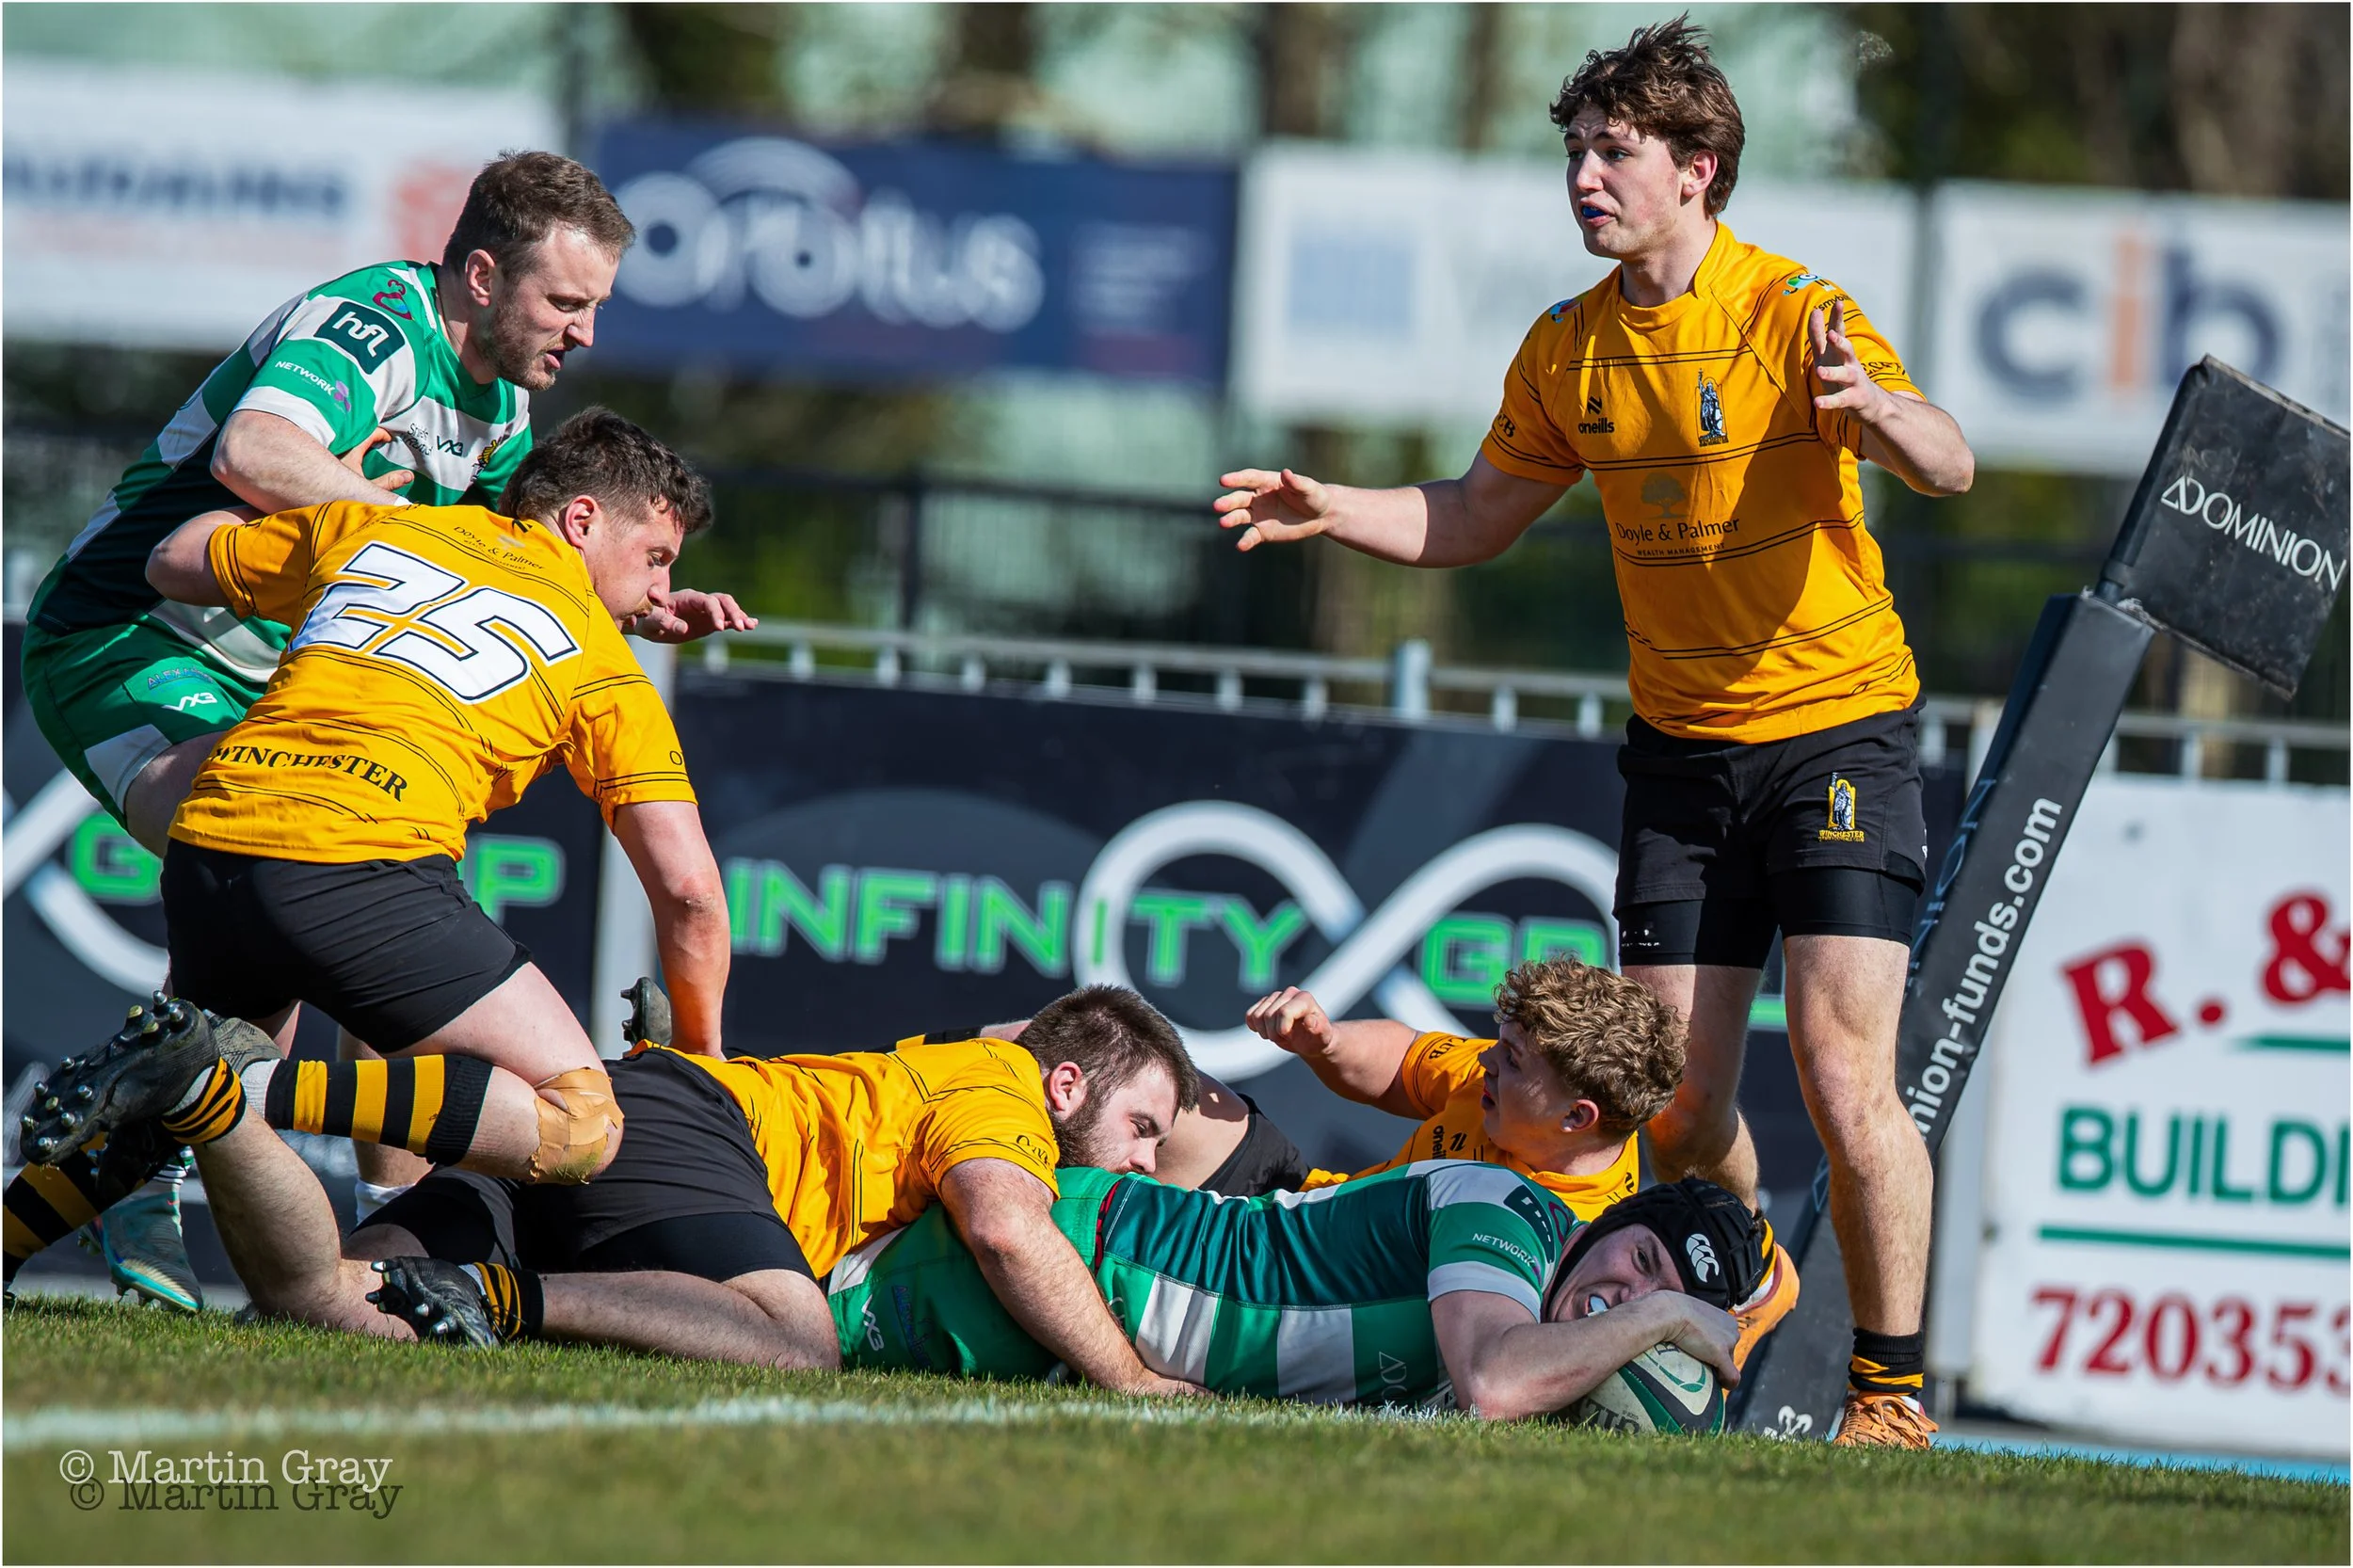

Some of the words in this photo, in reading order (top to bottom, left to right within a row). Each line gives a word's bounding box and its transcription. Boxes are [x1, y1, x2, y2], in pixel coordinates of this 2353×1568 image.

[275, 360, 336, 396] NETWORK
[503, 552, 546, 570] Palmer
[1615, 522, 1654, 546] Doyle
[1658, 523, 1673, 541] &
[1677, 518, 1740, 539] Palmer
[1667, 543, 1725, 555] MANAGEMENT
[2161, 475, 2347, 592] DOMINION
[286, 539, 583, 706] 25
[211, 745, 408, 803] WINCHESTER
[721, 856, 1310, 994] INFINITY
[1906, 796, 2063, 1142] nion-funds.com
[2059, 939, 2225, 1067] R.
[2261, 892, 2350, 1007] &
[2057, 1105, 2350, 1205] BUILDI
[1472, 1233, 1536, 1268] NETWORK
